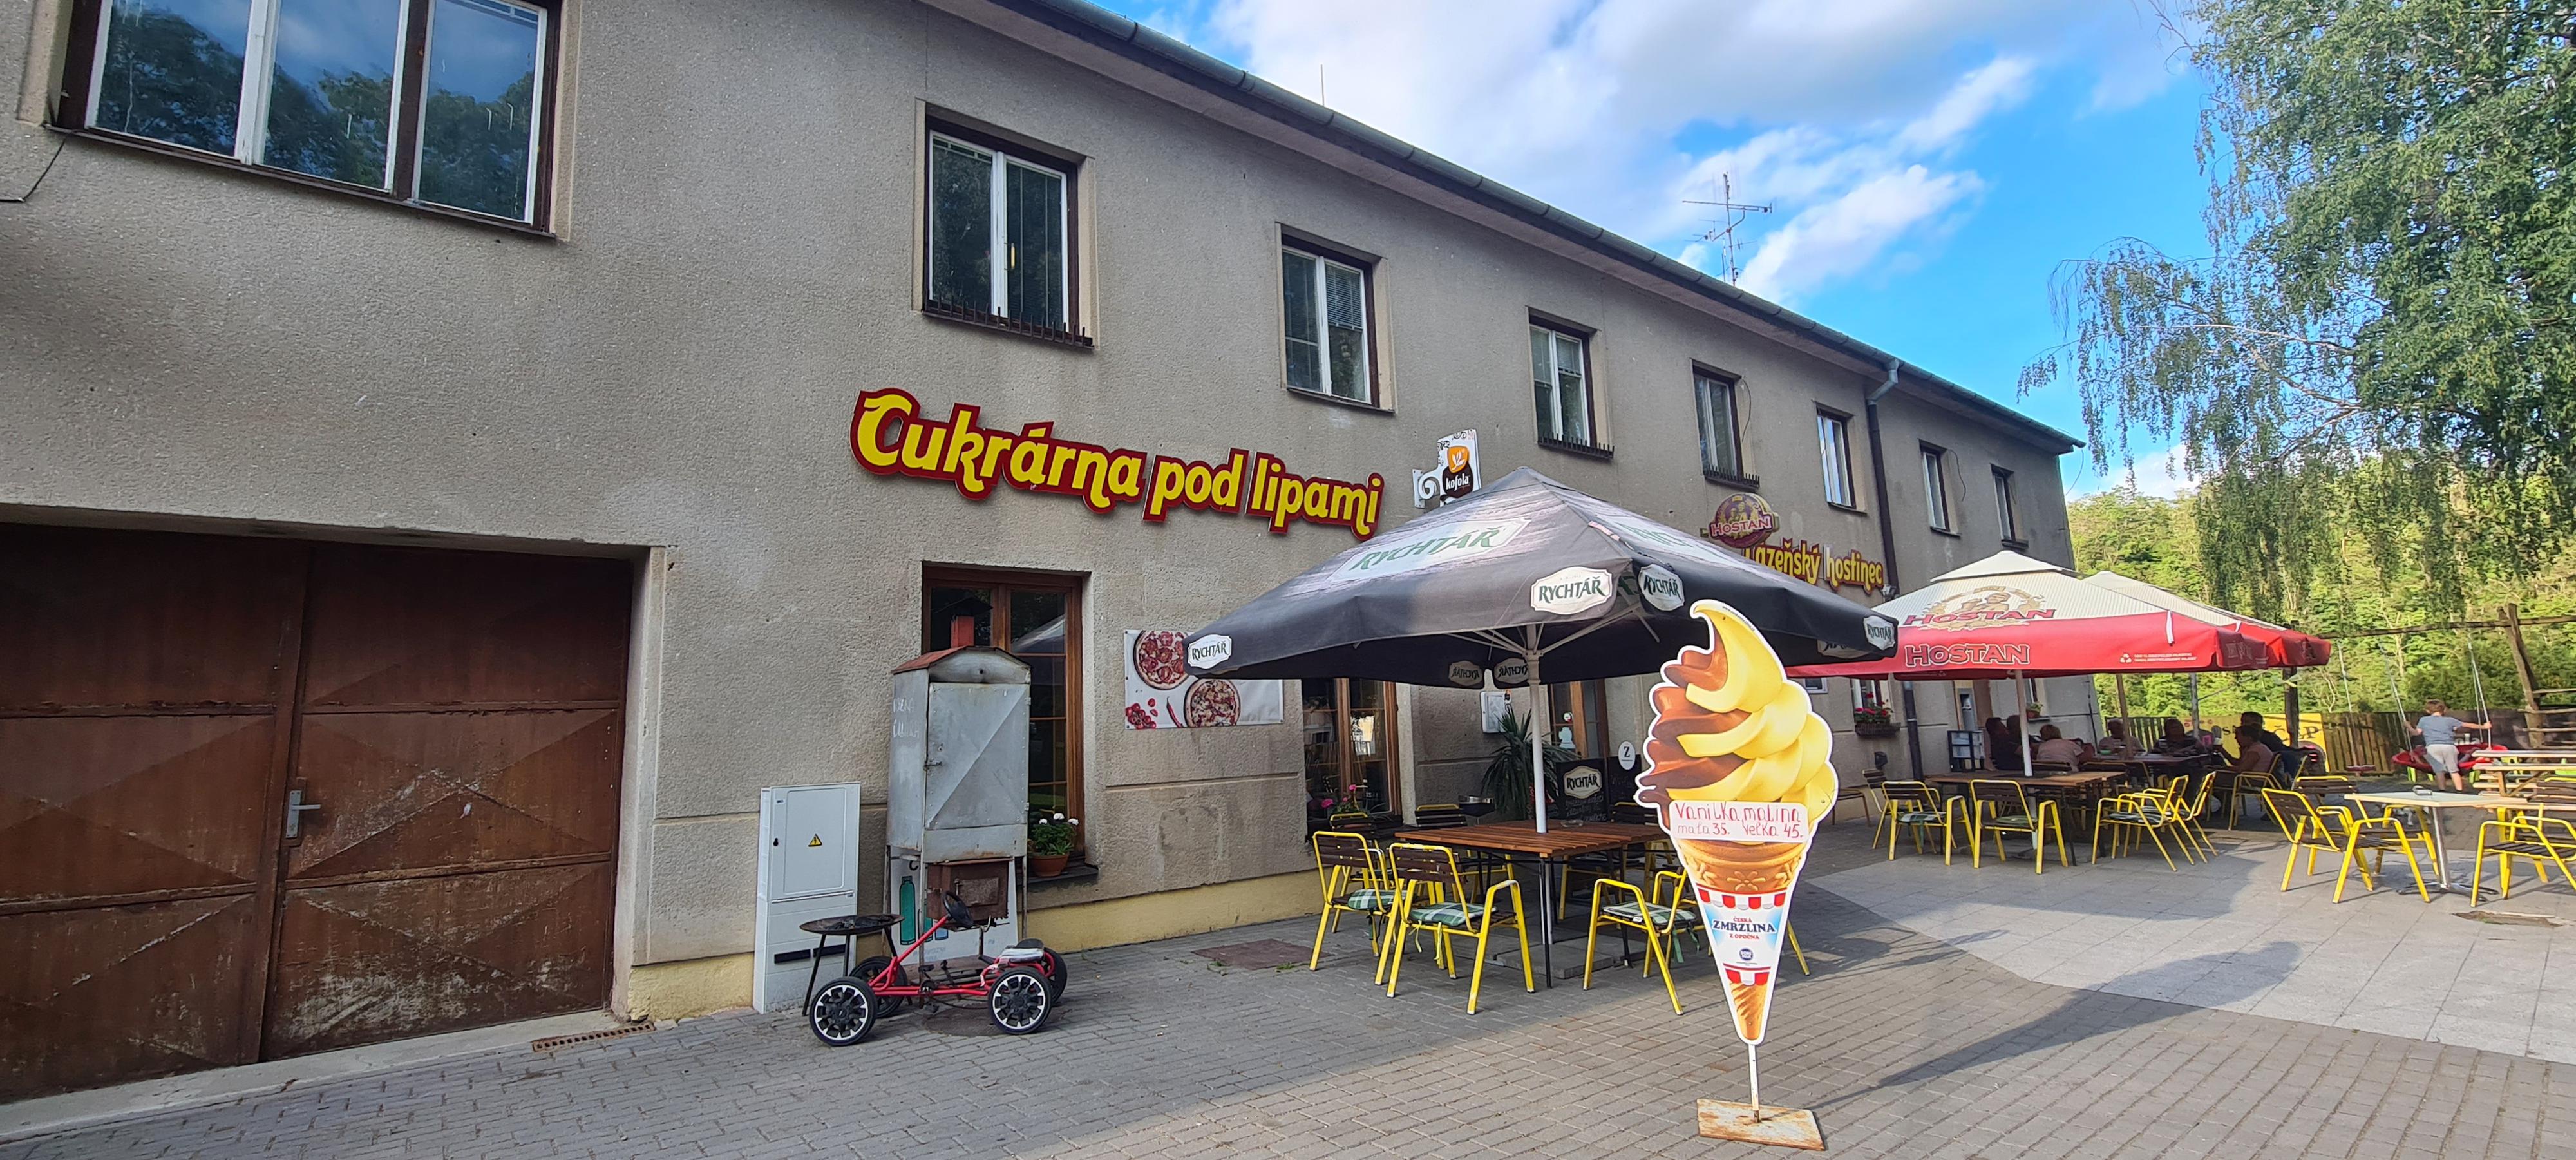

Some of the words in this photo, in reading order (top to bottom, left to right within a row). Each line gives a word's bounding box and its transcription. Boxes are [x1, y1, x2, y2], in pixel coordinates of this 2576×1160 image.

[857, 394, 1142, 508] Cukrárna
[1150, 453, 1244, 515] pod
[1251, 457, 1381, 535] lipami
[1446, 473, 1469, 491] kofola
[1711, 516, 1770, 537] HOSTAN
[1349, 525, 1505, 571] RYCHTÁŘ
[1826, 546, 1882, 591] hostinec
[1539, 576, 1607, 604] RYCHTÁŘ
[1643, 575, 1681, 600] RYCHTÁŘ
[1903, 609, 2057, 625] HOSTAN
[1191, 640, 1229, 661] RYCHTÁŘ
[1905, 644, 2030, 667] HOSTAN
[1624, 746, 1630, 758] Z
[1566, 774, 1600, 791] RYCHTÁŘ
[1713, 920, 1776, 933] ZMRZLINA
